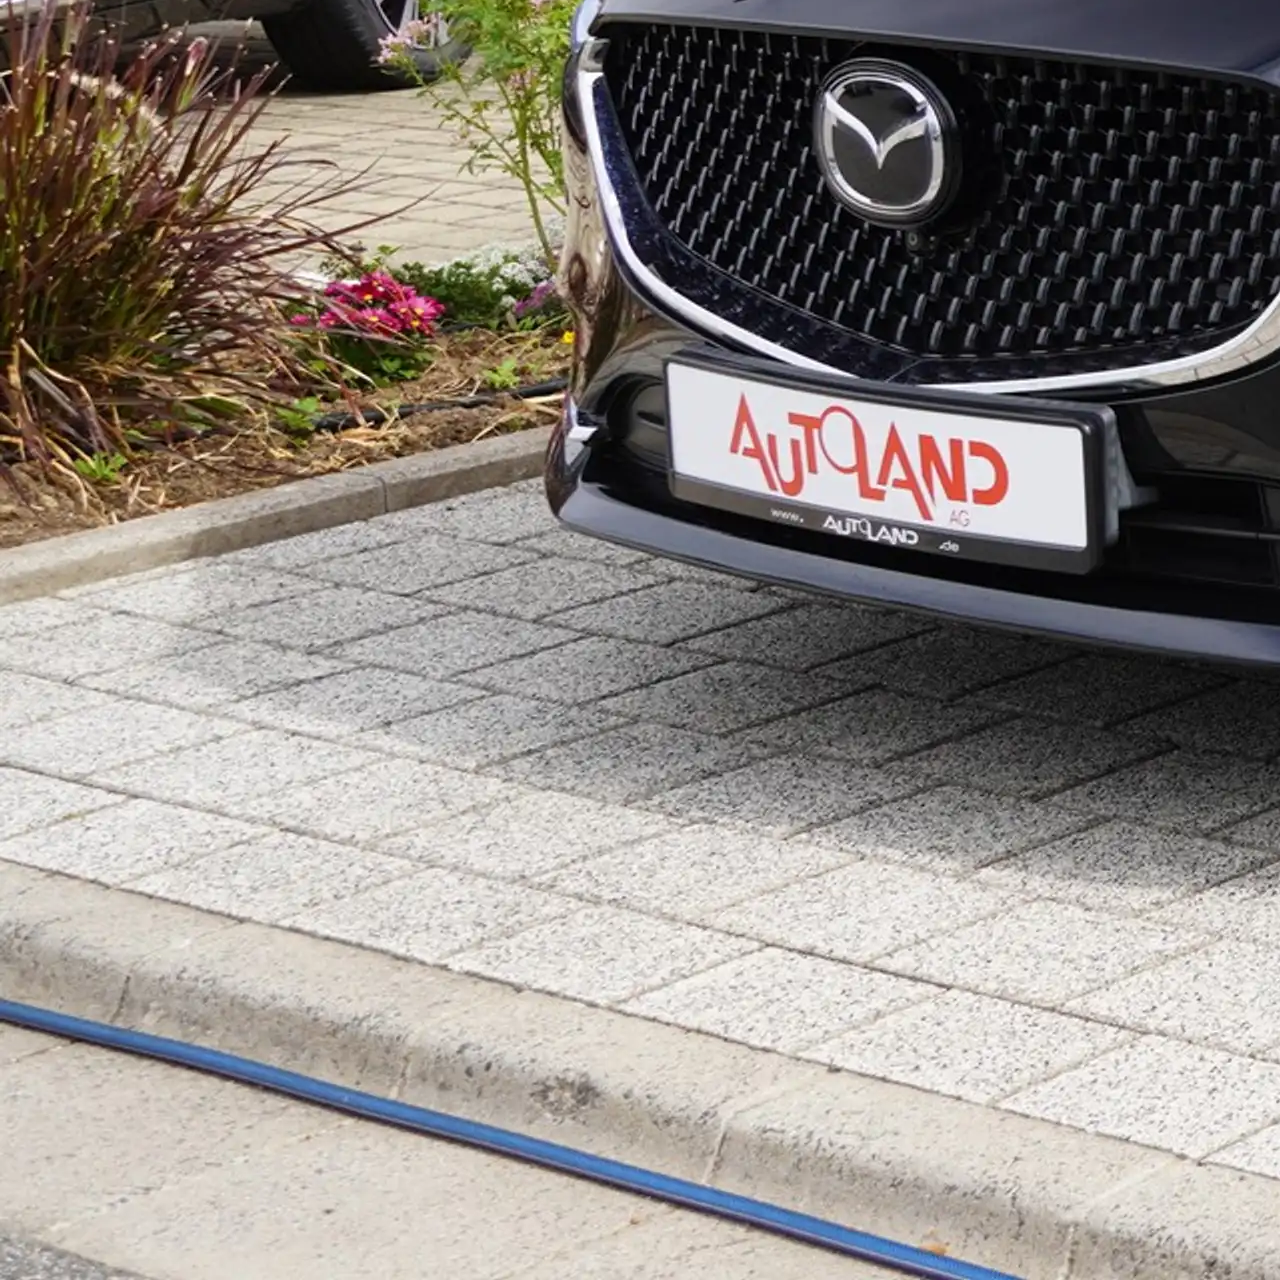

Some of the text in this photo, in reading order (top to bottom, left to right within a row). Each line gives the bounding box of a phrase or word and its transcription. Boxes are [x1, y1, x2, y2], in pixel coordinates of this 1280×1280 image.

[730, 392, 1009, 521] AUTOLAND
[822, 515, 920, 546] AUTOLAND
[939, 540, 959, 552] .de
[949, 509, 971, 527] AG
